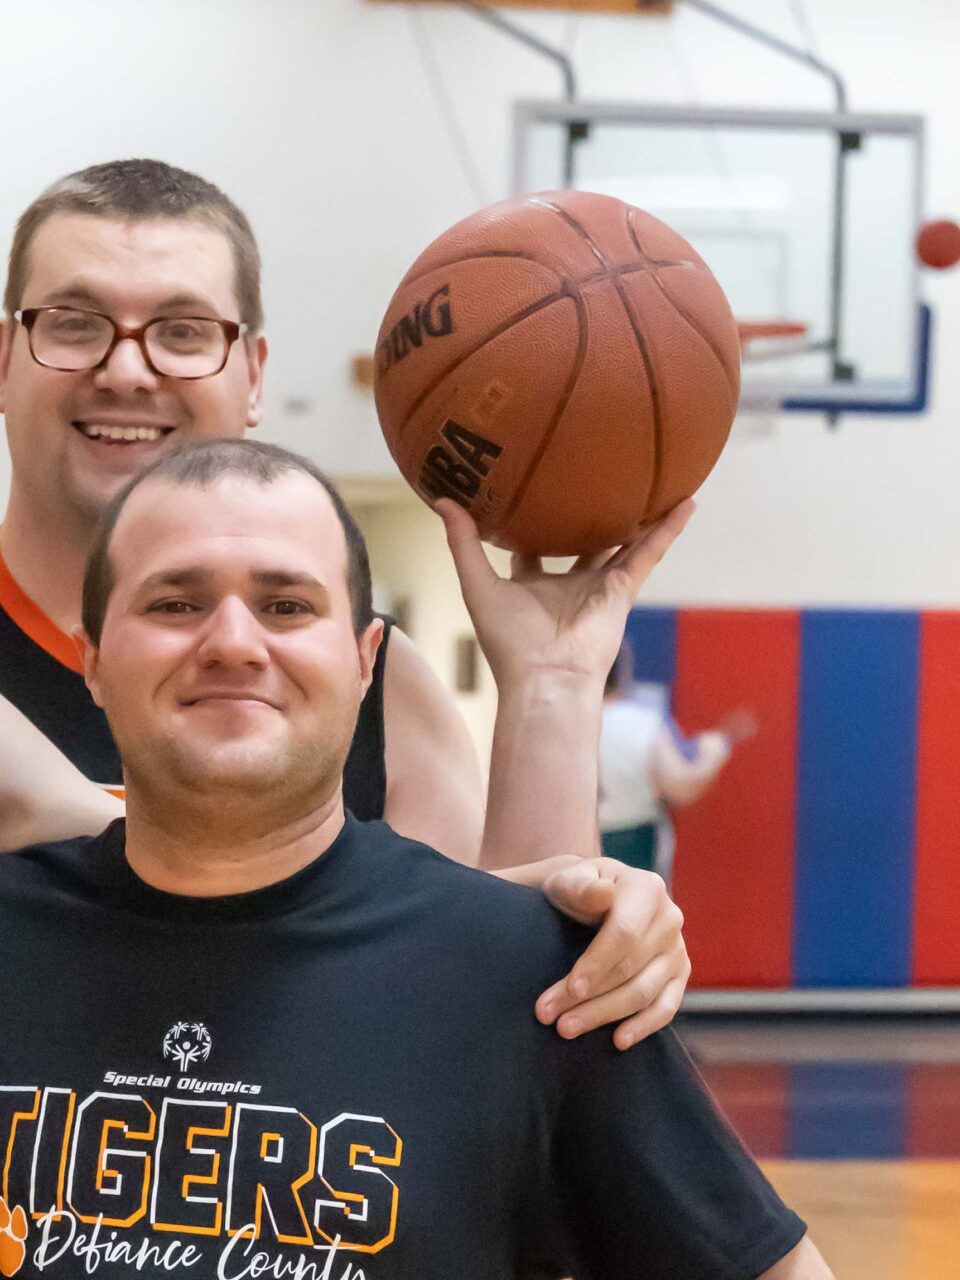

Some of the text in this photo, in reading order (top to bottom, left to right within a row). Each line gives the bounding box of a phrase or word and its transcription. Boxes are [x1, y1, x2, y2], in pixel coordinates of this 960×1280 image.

[103, 1071, 262, 1095] Special Olympics
[33, 1205, 202, 1273] Defiance
